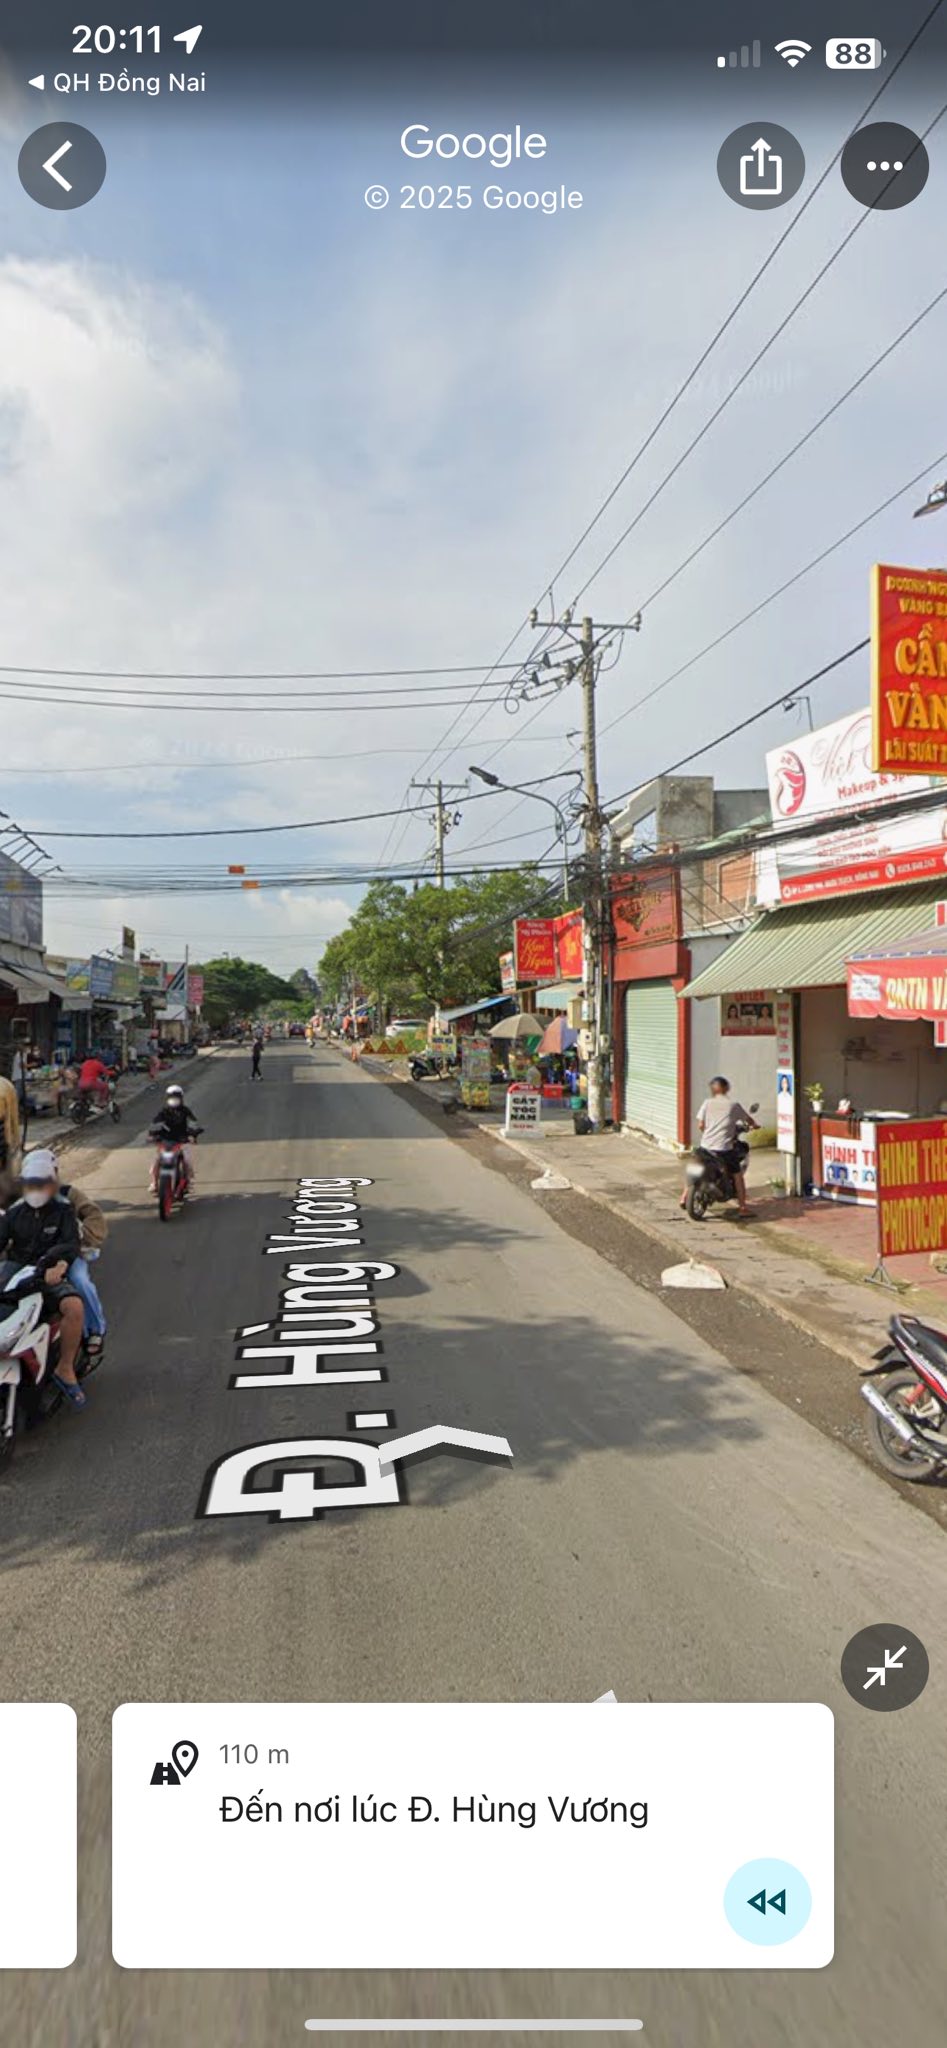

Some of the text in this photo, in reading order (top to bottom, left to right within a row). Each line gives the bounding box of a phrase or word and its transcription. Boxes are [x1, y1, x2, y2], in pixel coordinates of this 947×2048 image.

[837, 780, 877, 799] Makeup
[823, 1142, 858, 1165] HÌNH
[879, 1132, 919, 1187] HÌNH
